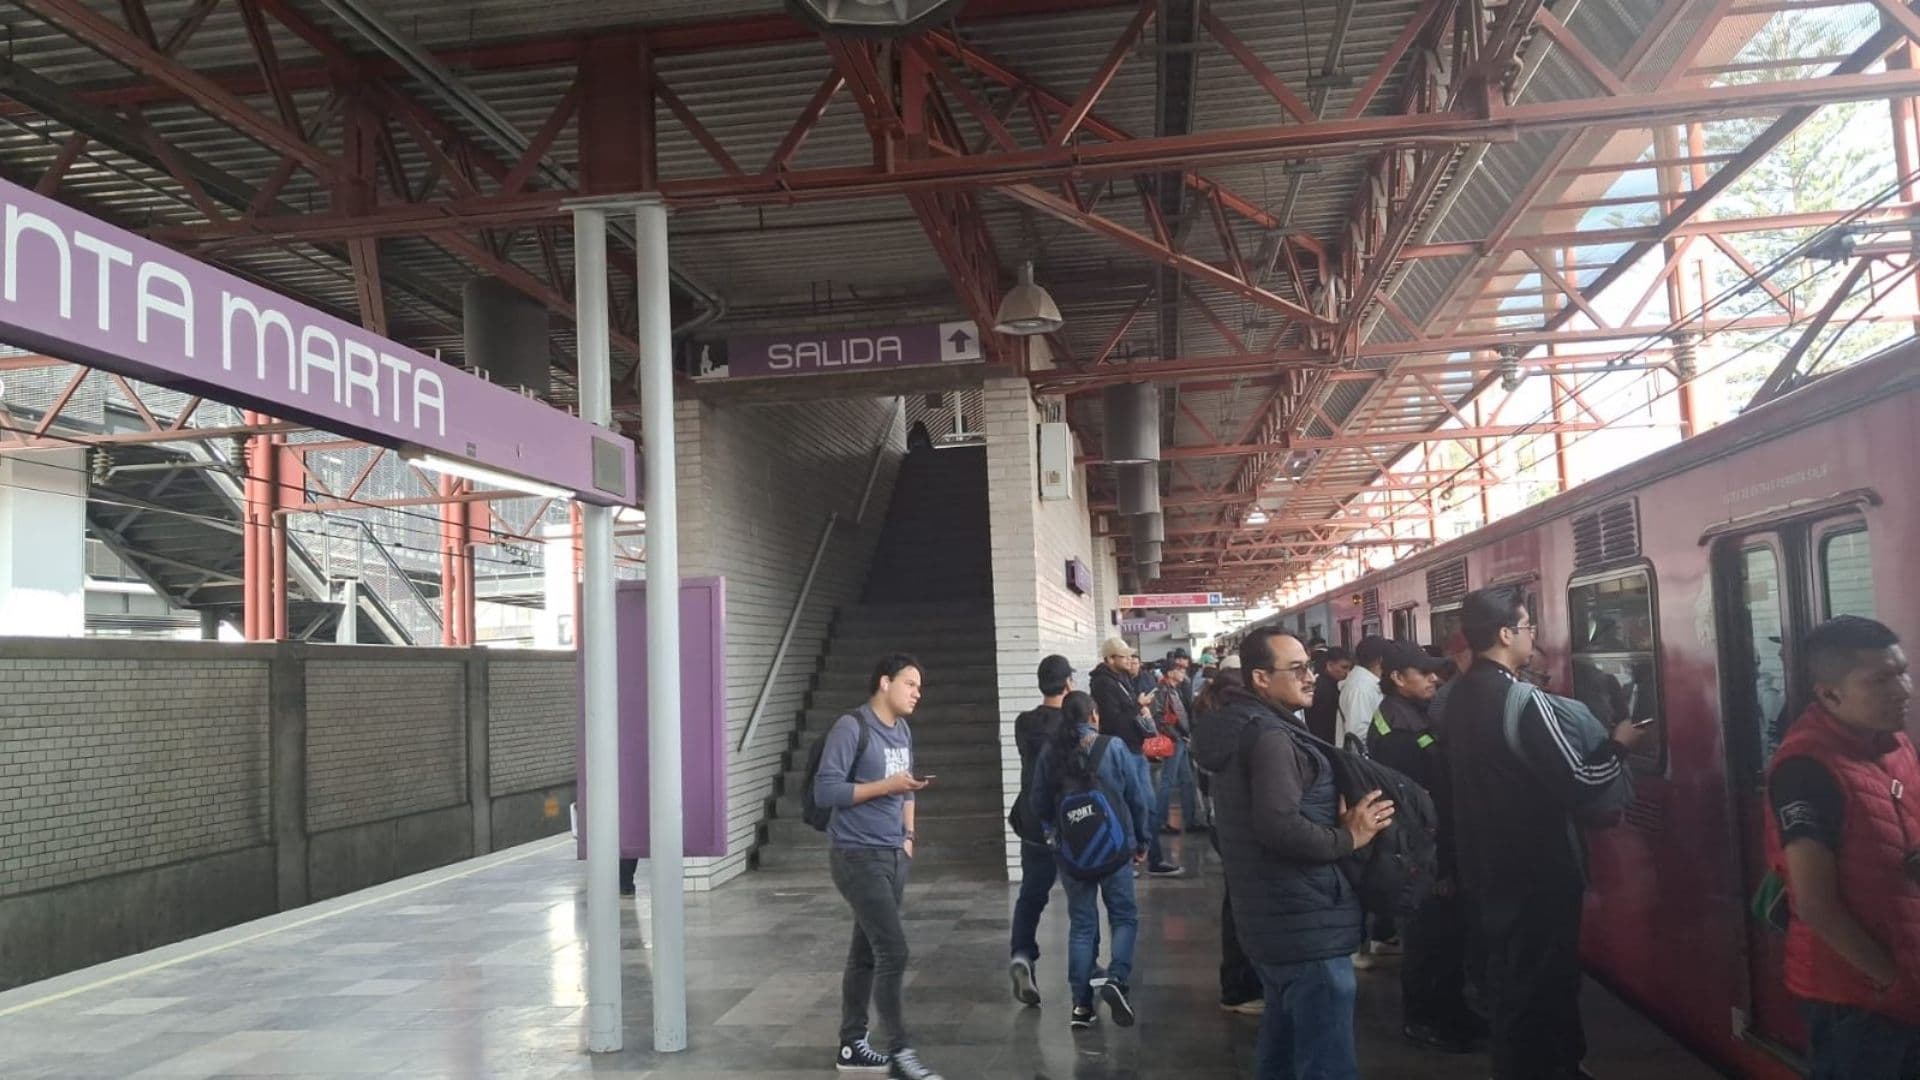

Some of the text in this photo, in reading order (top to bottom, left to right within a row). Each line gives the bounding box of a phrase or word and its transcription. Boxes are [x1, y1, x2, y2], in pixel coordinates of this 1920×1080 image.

[222, 291, 445, 437] MARTA
[768, 337, 901, 369] SALIDA
[1066, 804, 1095, 822] SPORT
